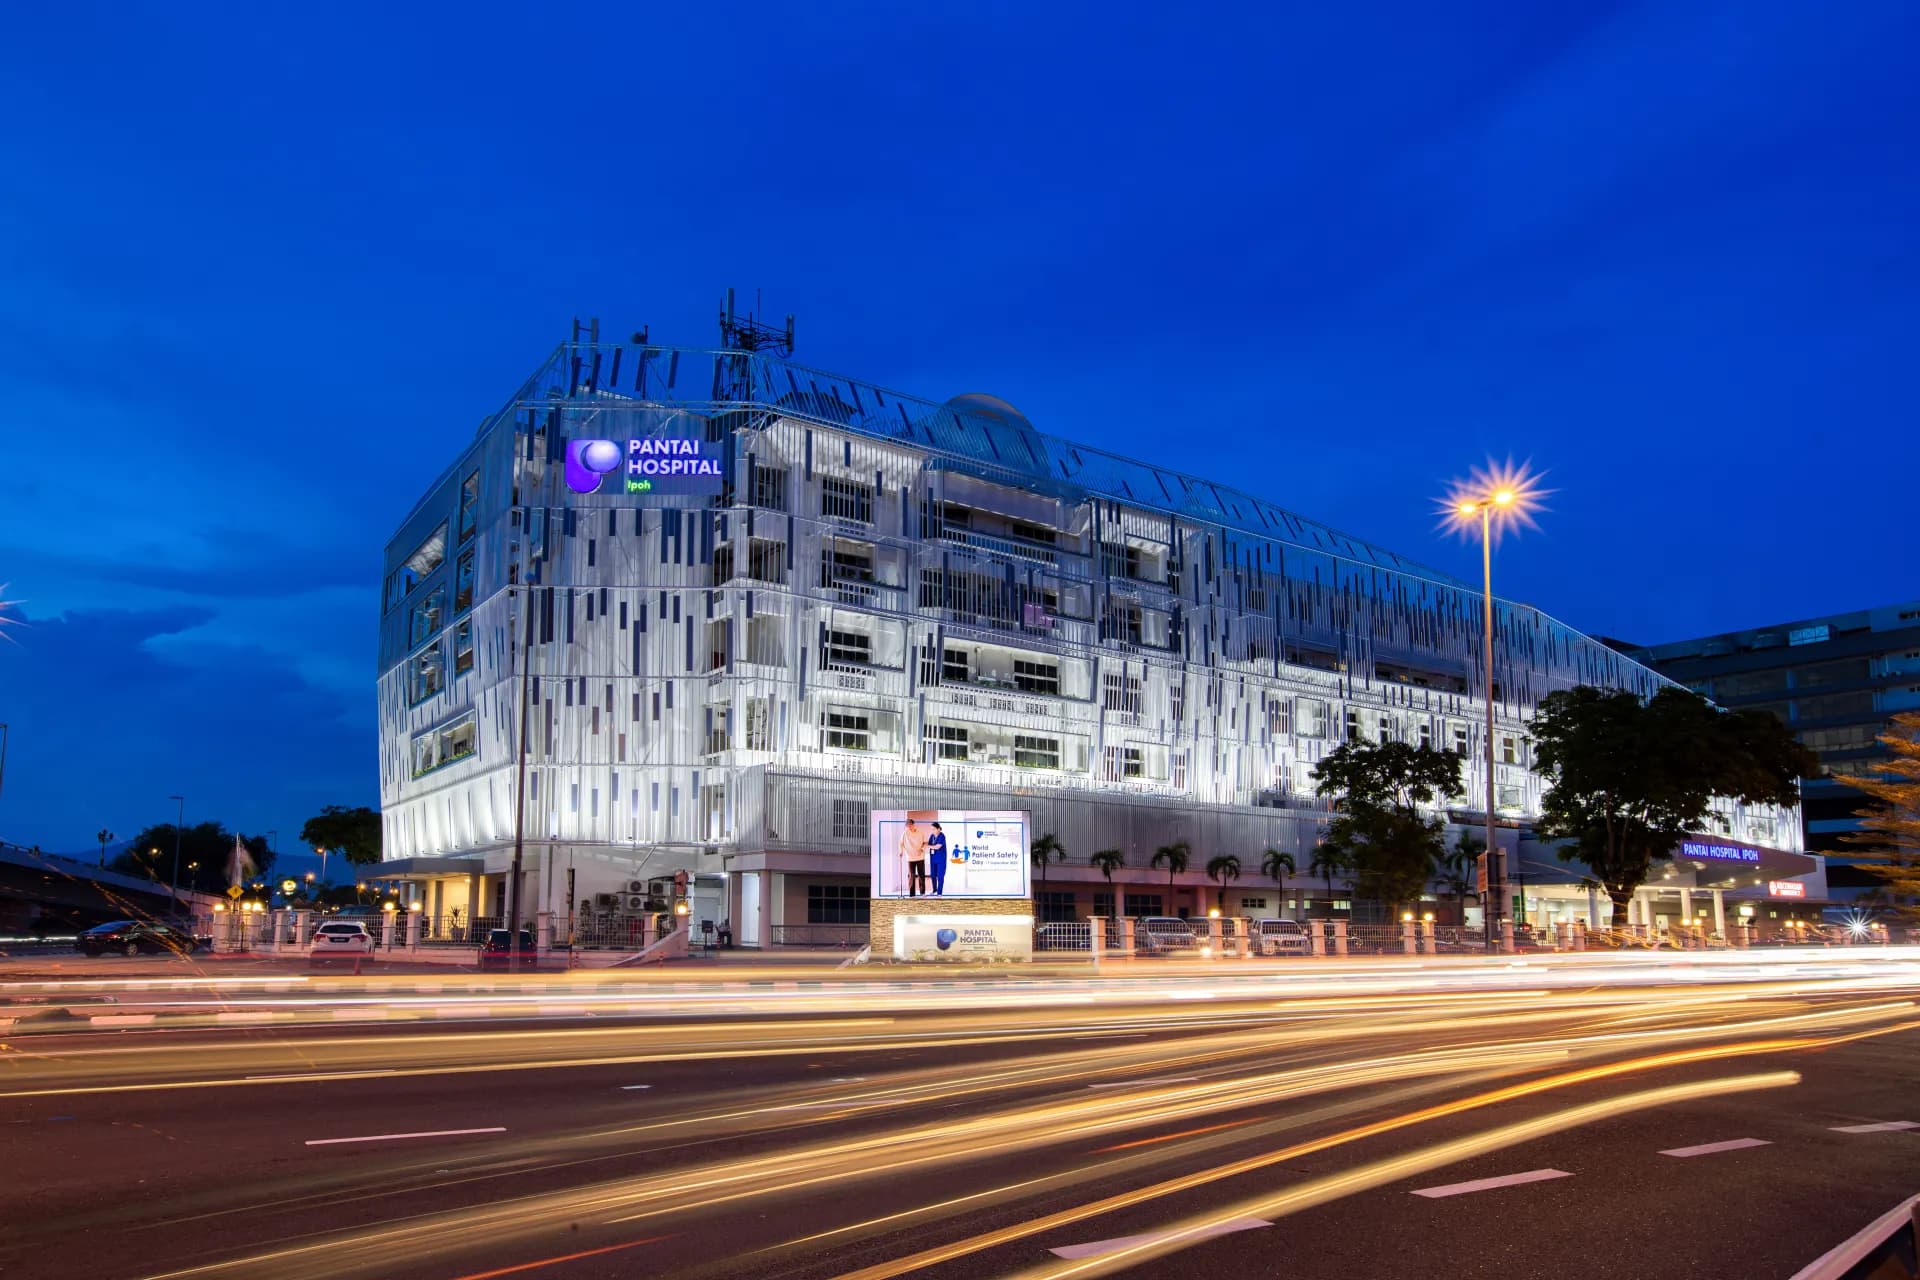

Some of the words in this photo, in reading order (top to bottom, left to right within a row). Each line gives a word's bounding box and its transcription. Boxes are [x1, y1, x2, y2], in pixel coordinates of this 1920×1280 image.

[629, 440, 698, 454] PANTAI
[628, 459, 721, 474] HOSPITAL
[627, 480, 651, 492] Ipoh
[1683, 843, 1709, 857] PANTAI
[1709, 845, 1741, 860] HOSPITAL
[1742, 848, 1758, 861] IPOH
